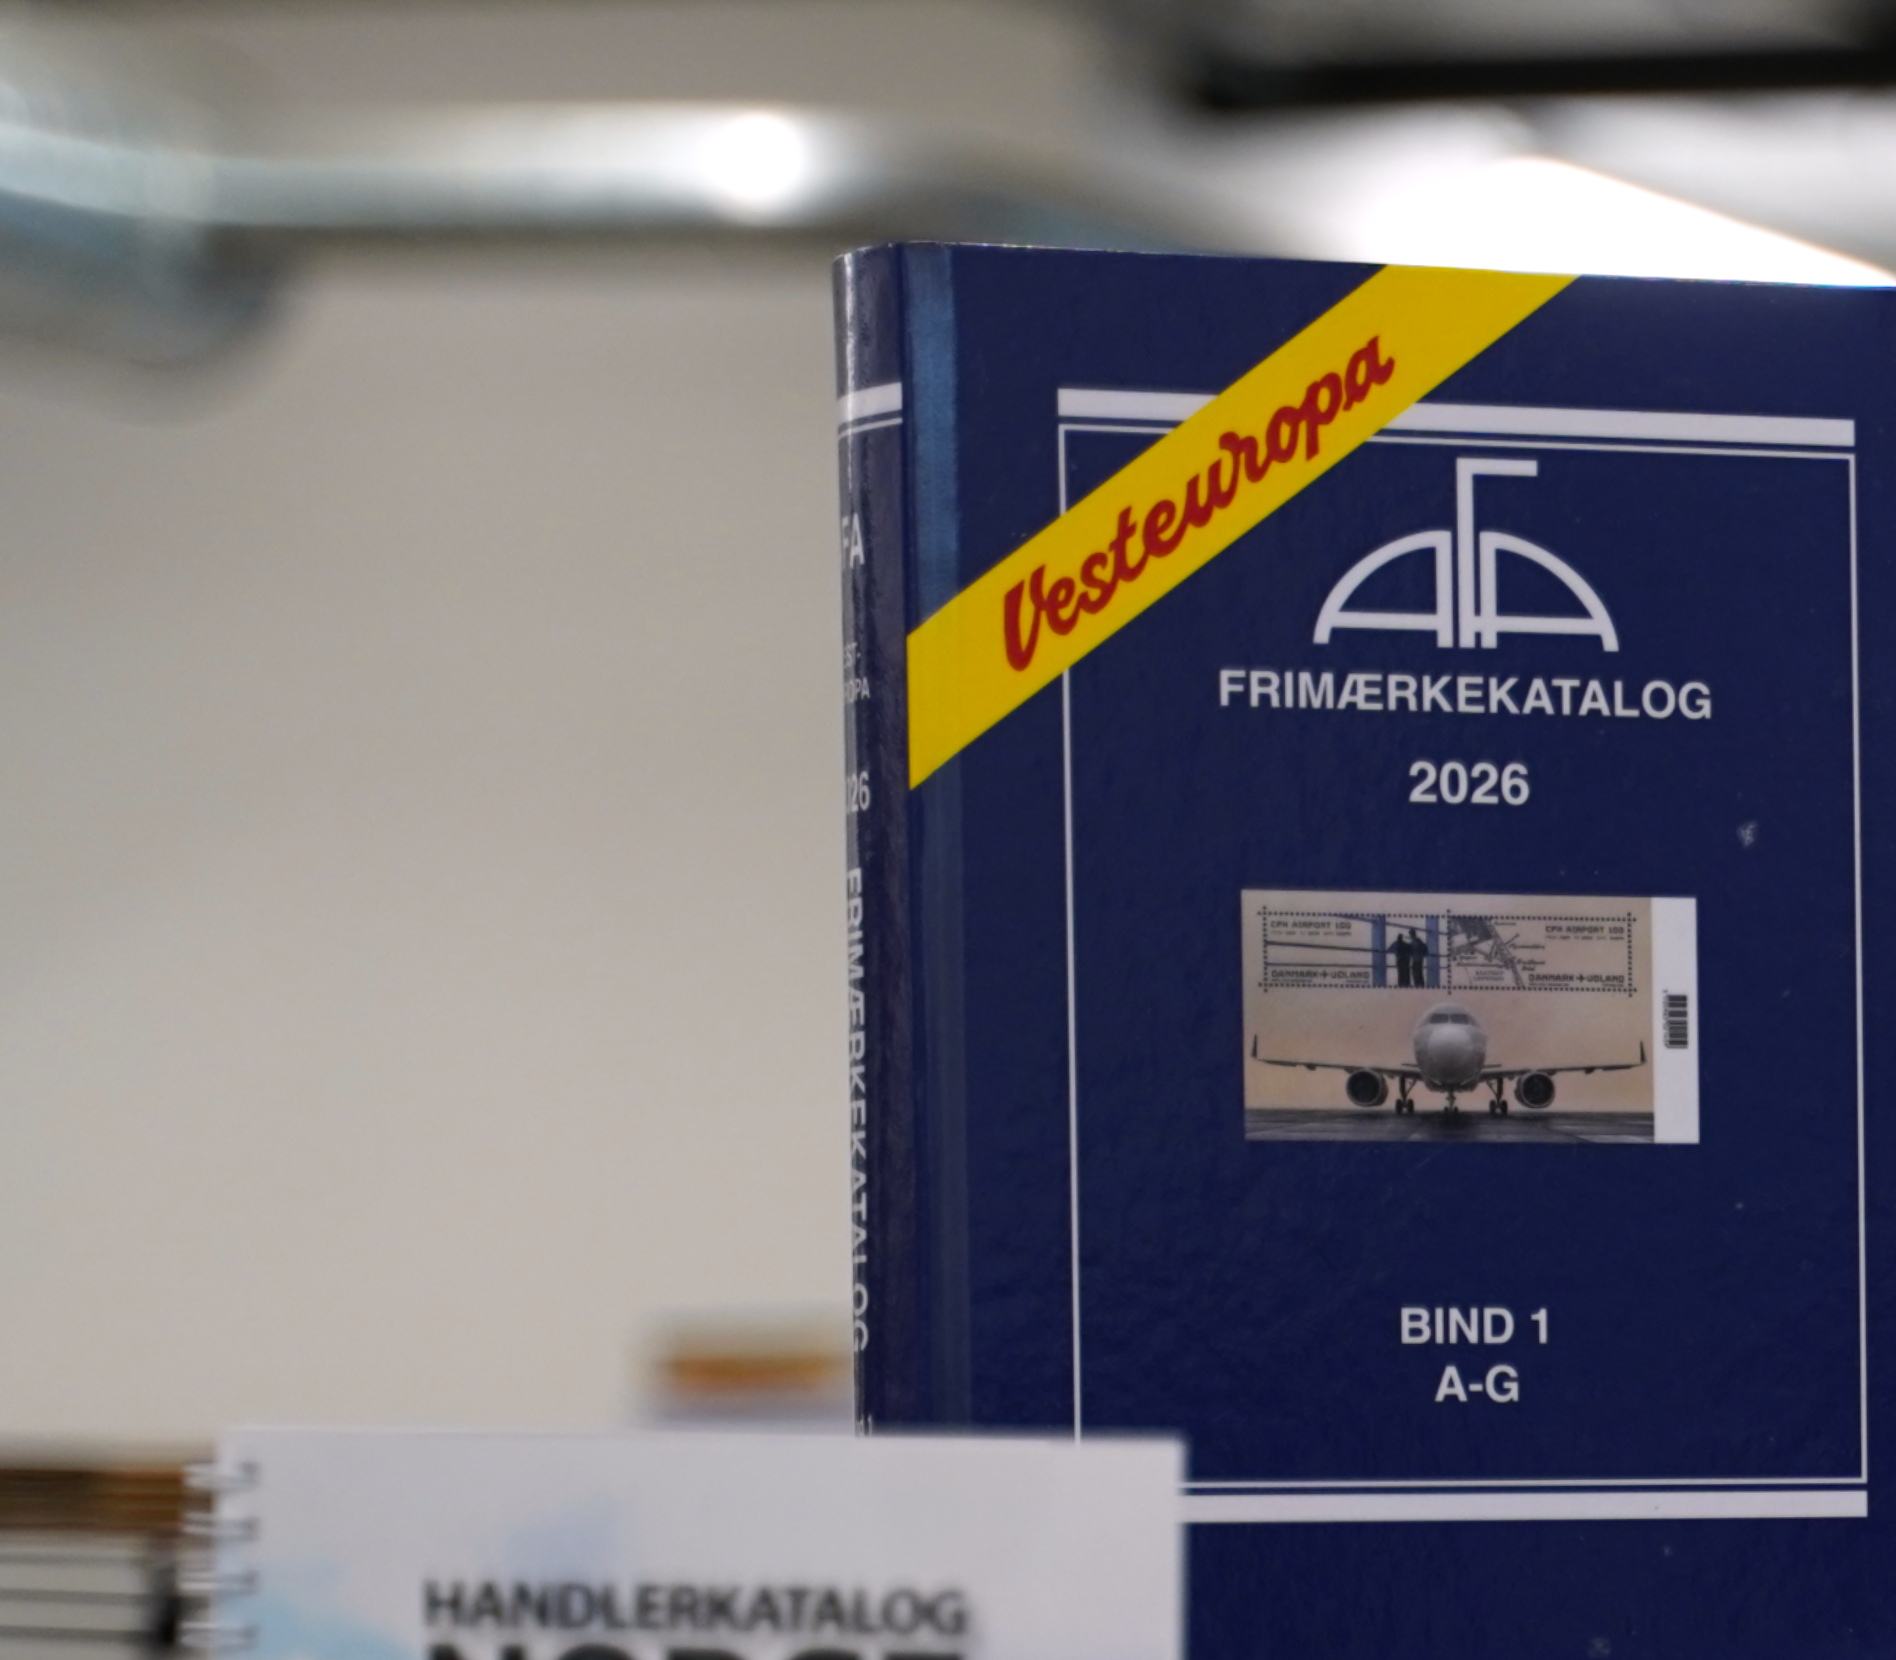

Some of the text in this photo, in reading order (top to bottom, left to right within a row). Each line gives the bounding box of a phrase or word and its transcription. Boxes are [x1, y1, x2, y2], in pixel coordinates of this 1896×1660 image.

[1001, 336, 1396, 673] Vesteuropa
[1219, 669, 1712, 719] FRIMÆRKEKATALOG
[1409, 760, 1531, 806] 2026
[1528, 972, 1575, 982] DANMARK
[1398, 1306, 1551, 1345] BIND 1
[1434, 1365, 1521, 1404] A-G
[423, 1580, 968, 1637] HANDLERKATALOG
